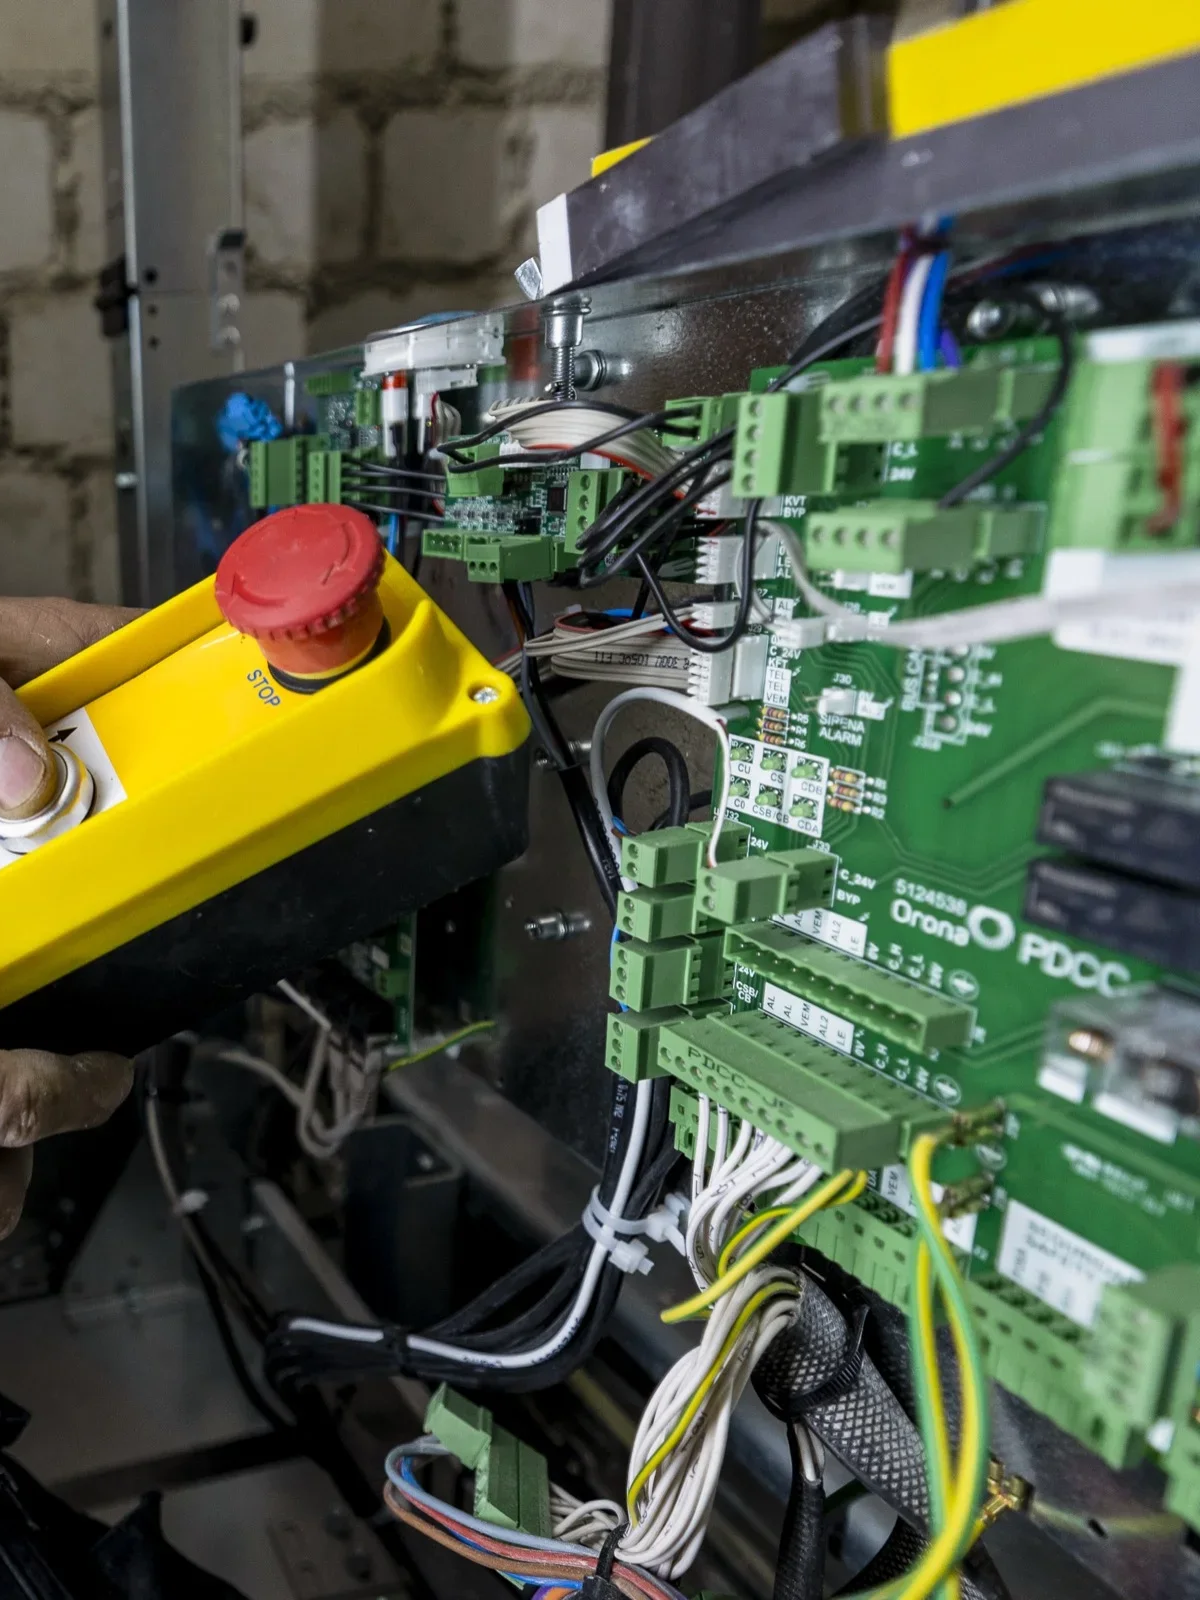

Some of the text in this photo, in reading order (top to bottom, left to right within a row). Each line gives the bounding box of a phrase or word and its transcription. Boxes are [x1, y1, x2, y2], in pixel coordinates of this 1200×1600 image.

[784, 495, 806, 506] KVT
[783, 507, 806, 518] BYP
[776, 568, 791, 578] AL
[778, 601, 791, 610] AL
[768, 656, 788, 668] KFT
[768, 669, 787, 680] TEL
[247, 669, 281, 706] STOP
[768, 681, 786, 692] TEL
[766, 692, 788, 704] VEM
[819, 714, 865, 734] SIRENA
[794, 738, 807, 749] R6
[819, 727, 862, 747] ALARM
[738, 763, 750, 774] CU
[771, 773, 783, 783] CS
[801, 782, 823, 796] CDB
[797, 819, 820, 833] CDA
[751, 837, 769, 850] 24V
[839, 868, 876, 889] C_24V
[837, 889, 861, 905] BYP
[812, 910, 822, 934] VEM
[890, 898, 970, 947] Orona
[831, 920, 842, 942] AL2
[738, 965, 755, 978] 24V
[1017, 932, 1131, 999] PDCC
[766, 995, 775, 1010] AL
[783, 1004, 792, 1019] AL
[801, 1003, 812, 1027] VEM
[818, 1015, 829, 1038] AL2
[837, 1030, 846, 1046] LE
[855, 1039, 865, 1058] 0V
